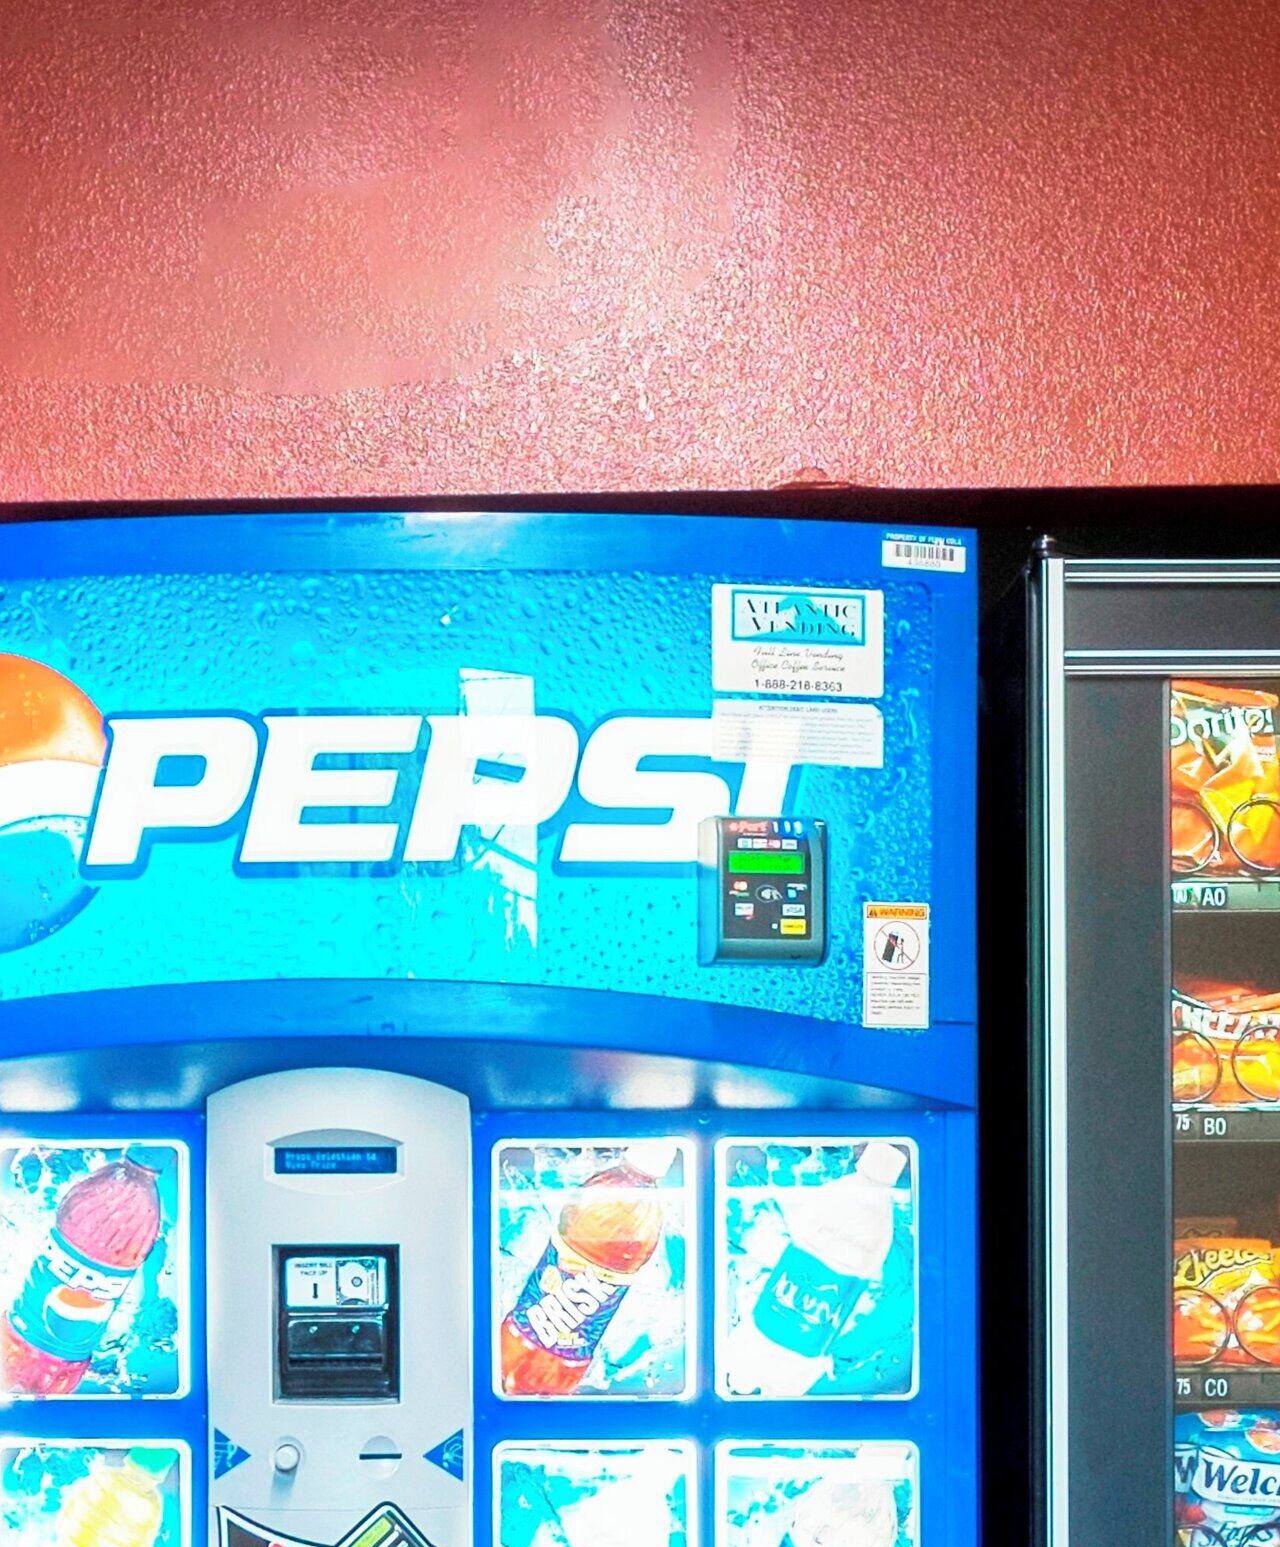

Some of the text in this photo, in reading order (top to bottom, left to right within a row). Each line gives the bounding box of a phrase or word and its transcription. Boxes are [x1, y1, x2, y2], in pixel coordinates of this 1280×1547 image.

[746, 598, 857, 619] ATLANTIC
[752, 616, 856, 637] VENDING
[754, 679, 843, 693] 1-888-218-8363
[1202, 886, 1227, 907] A0
[879, 907, 926, 918] WARNING
[1204, 1117, 1227, 1136] B0
[526, 1270, 620, 1350] BRISK
[1204, 1378, 1228, 1397] C0
